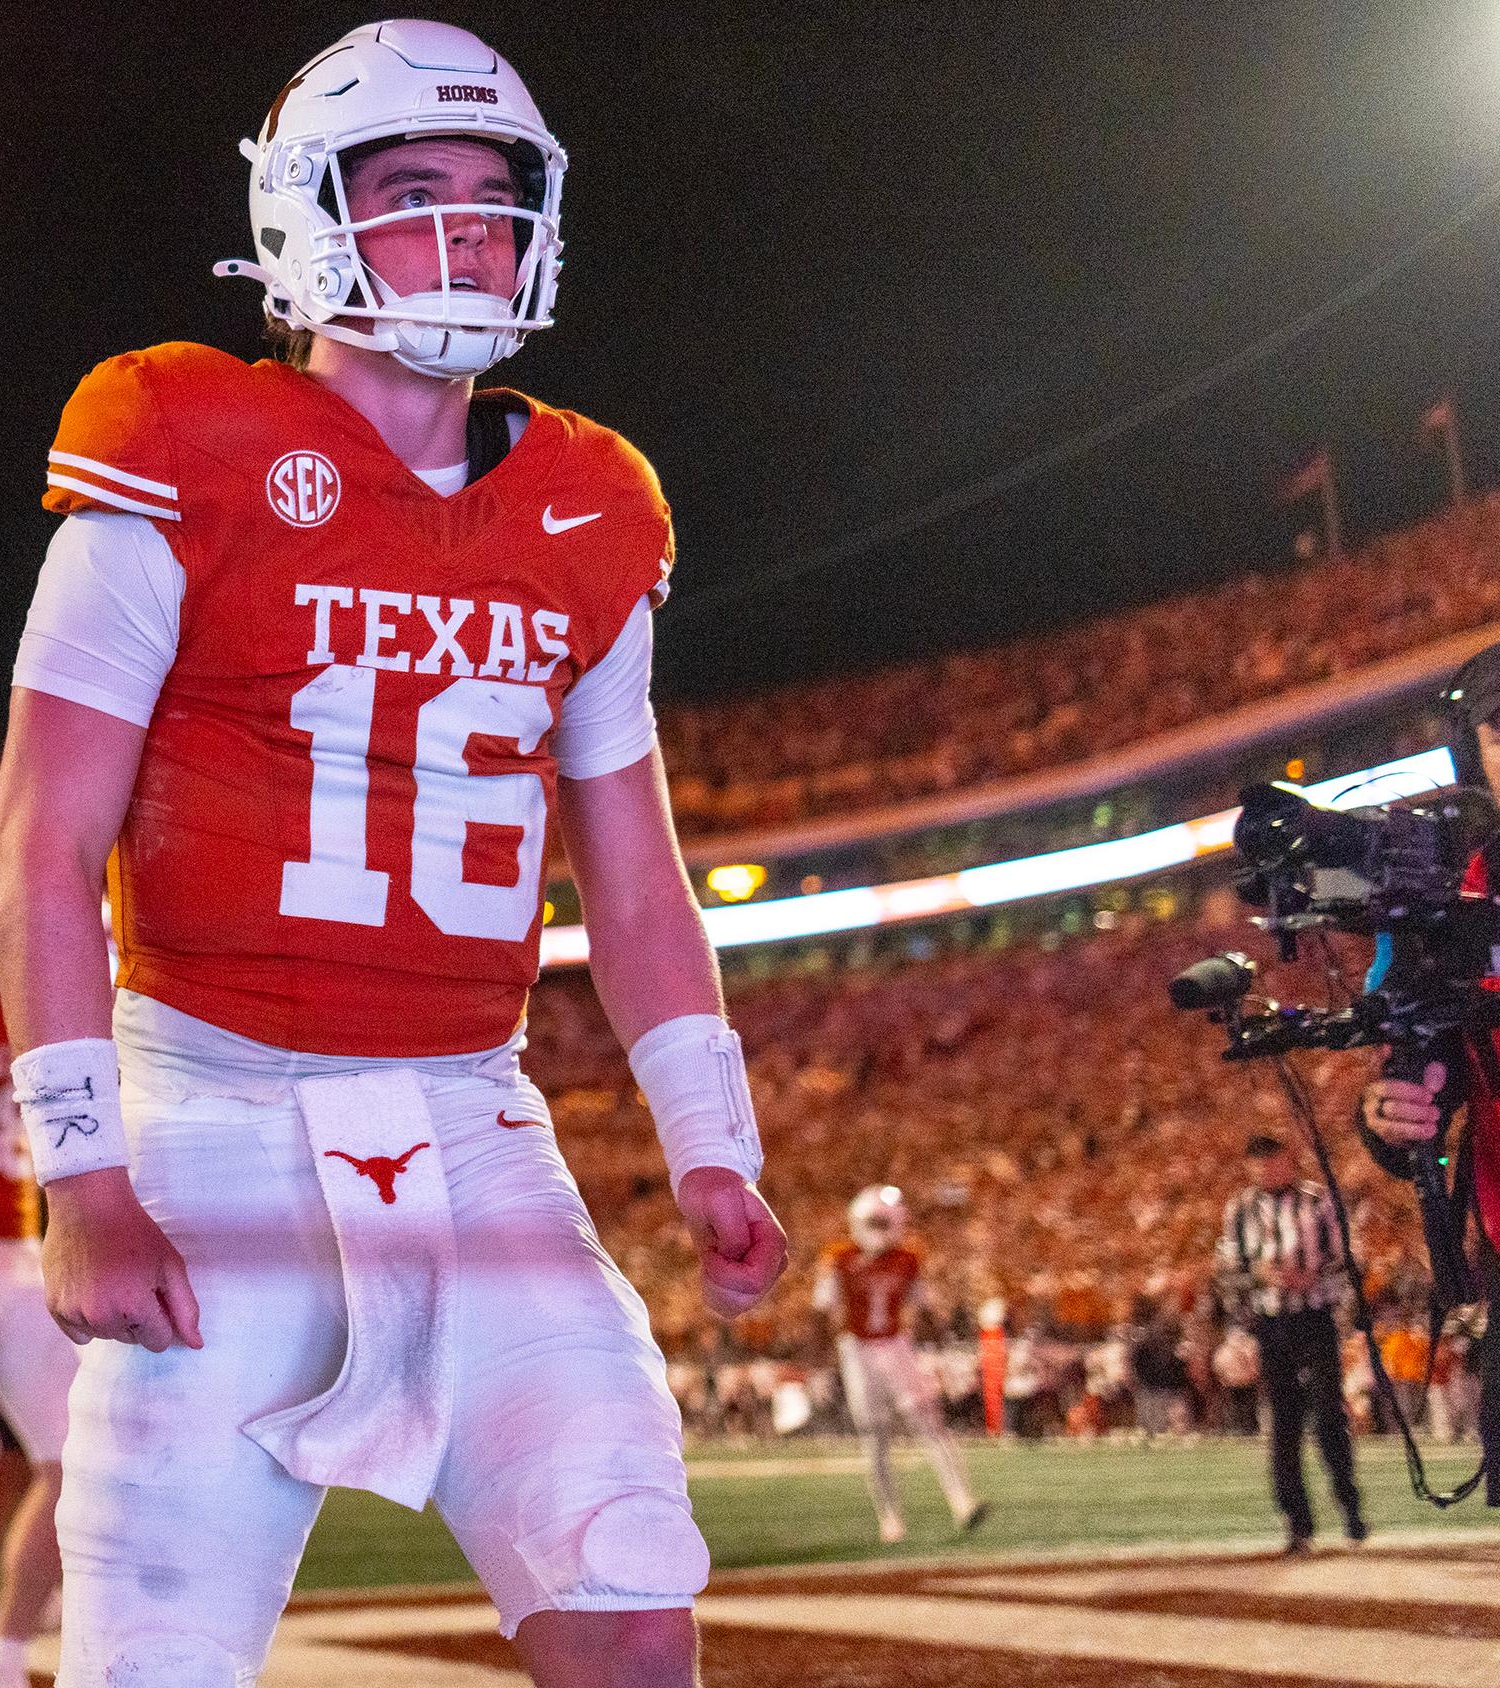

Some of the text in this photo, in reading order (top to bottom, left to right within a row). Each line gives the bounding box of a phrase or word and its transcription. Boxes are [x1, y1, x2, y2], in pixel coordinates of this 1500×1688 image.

[436, 84, 499, 105] HORNS
[274, 456, 334, 521] SEC
[294, 583, 569, 683] TEXAS
[279, 664, 554, 942] 16
